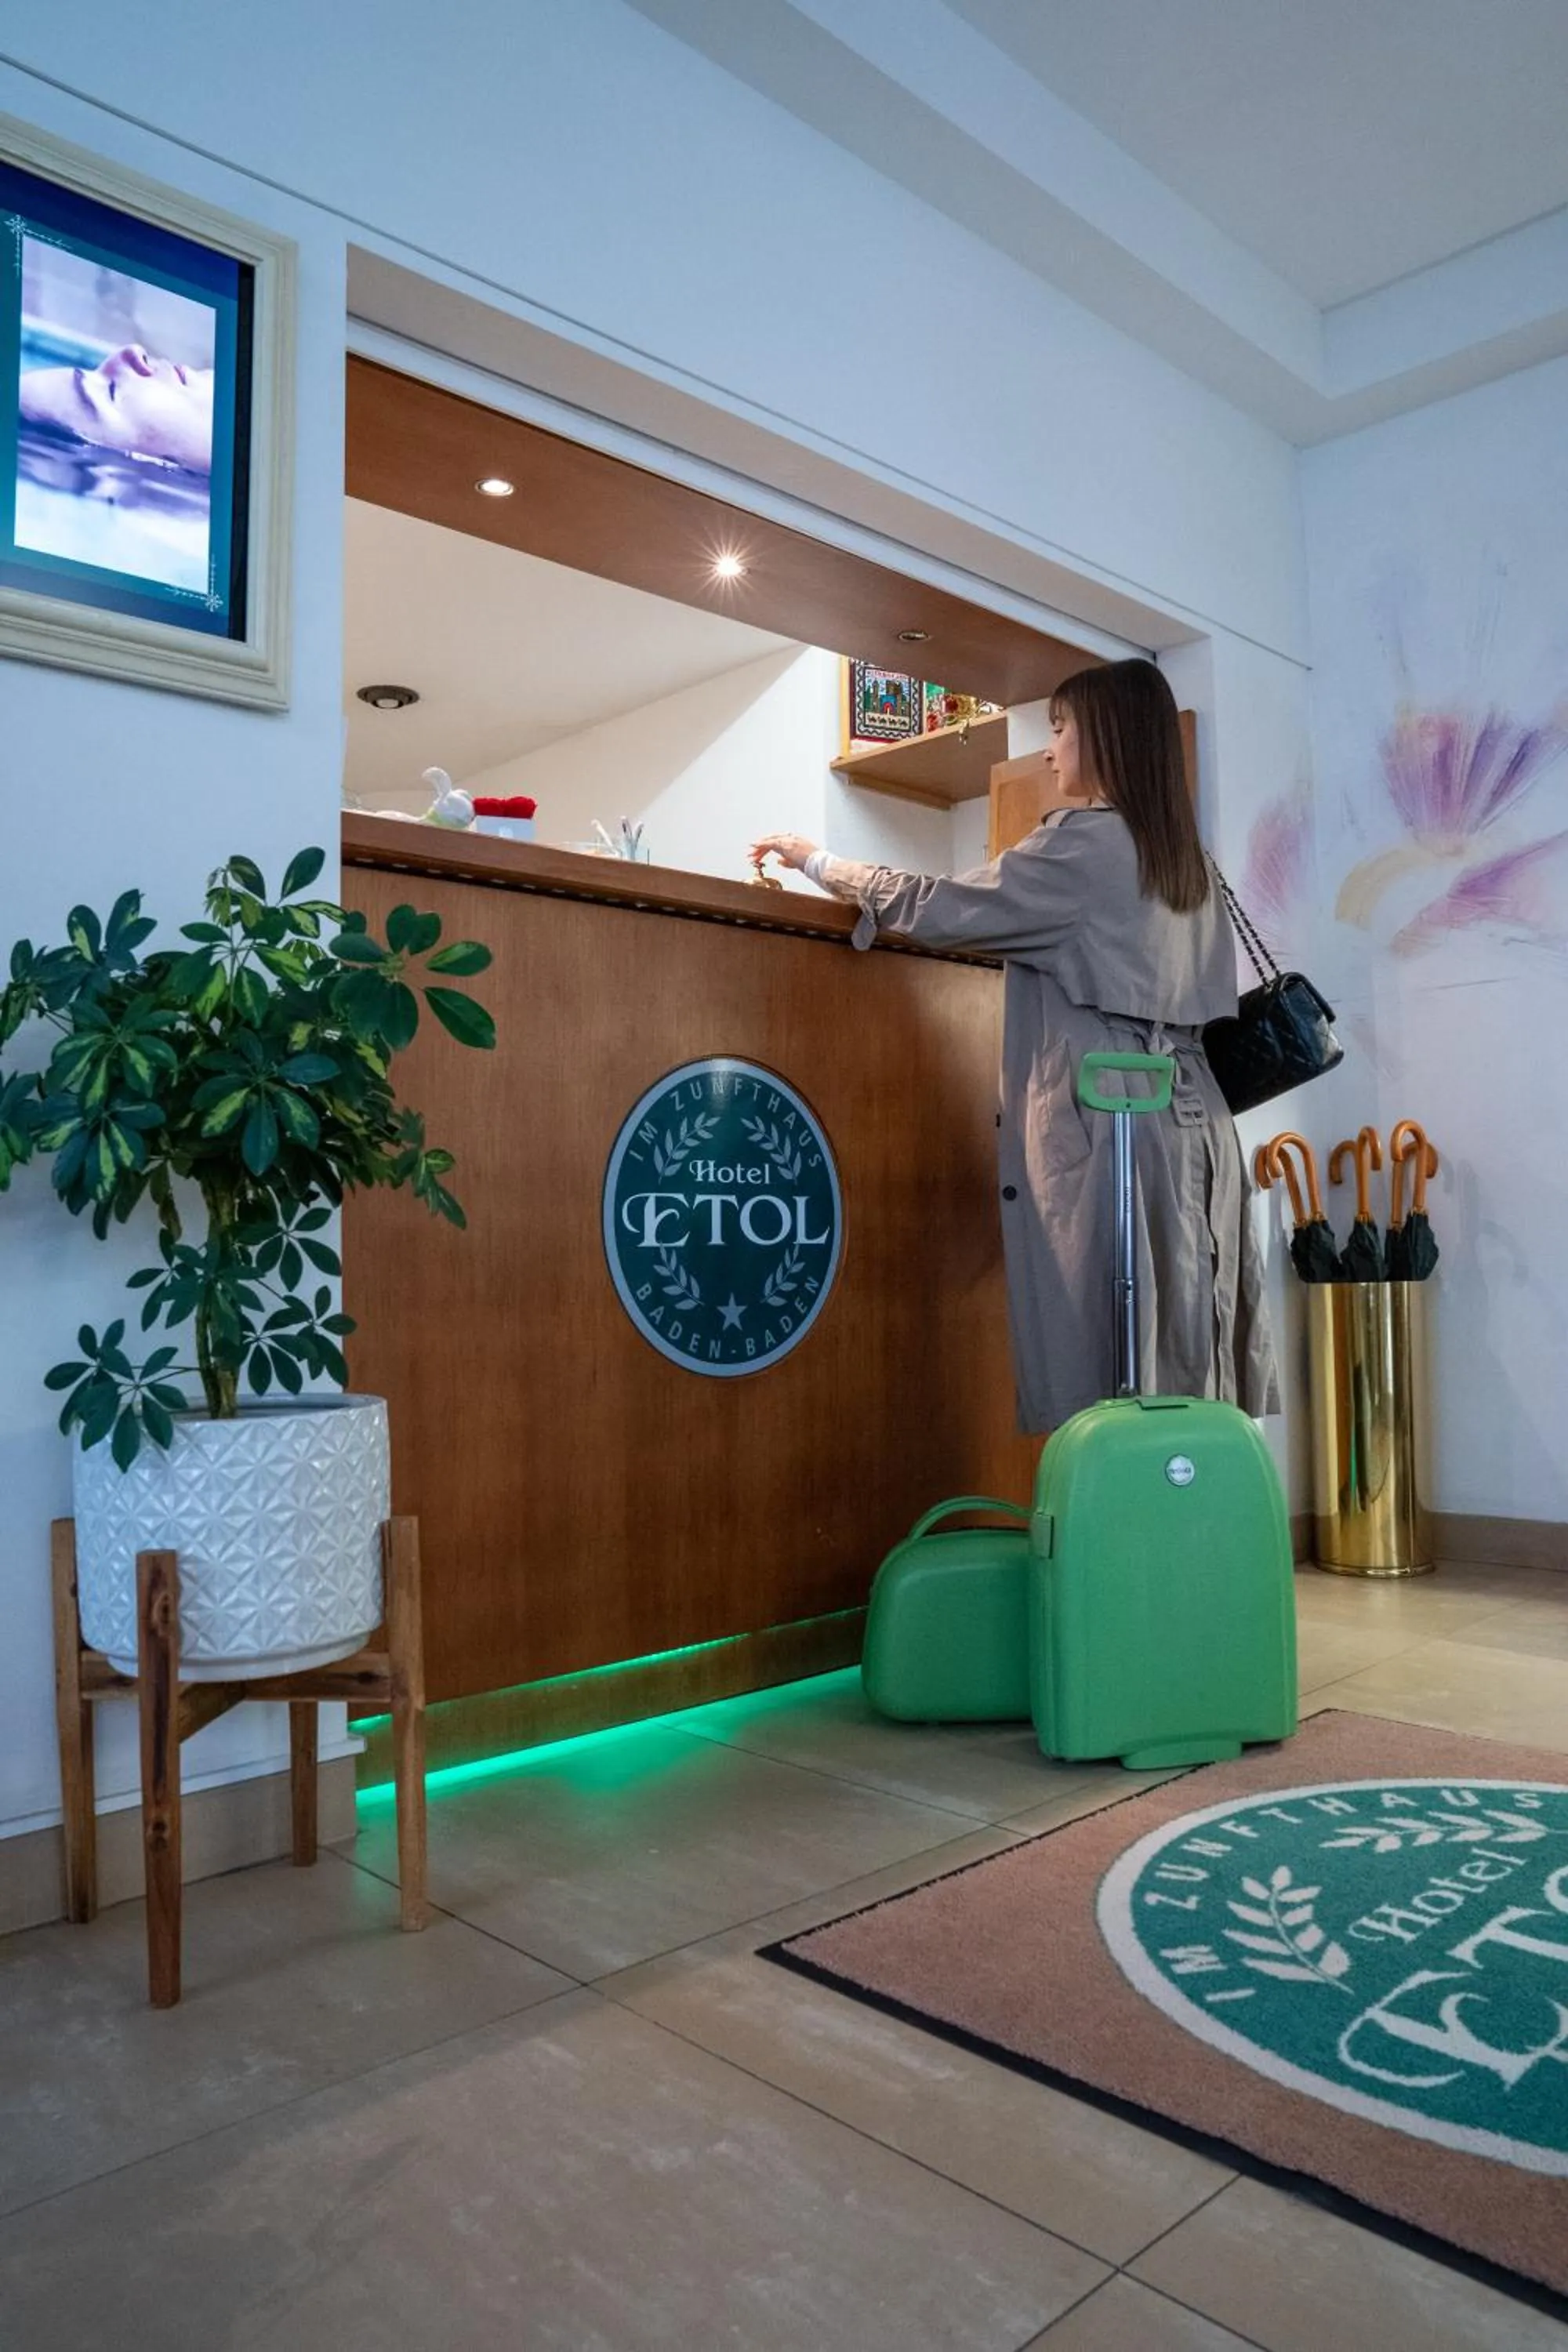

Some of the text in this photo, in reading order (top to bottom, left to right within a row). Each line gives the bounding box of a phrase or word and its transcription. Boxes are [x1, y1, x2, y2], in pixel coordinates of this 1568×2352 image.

[630, 1076, 823, 1167] IM ZUNFTHAUS
[689, 1160, 771, 1185] Hotel
[622, 1192, 831, 1247] ETOL
[637, 1276, 821, 1359] BADEN-BADEN
[1144, 1788, 1544, 2002] IM ZUNFTHAUS
[1348, 1847, 1527, 1944] Hotel
[1338, 1864, 1568, 2092] ET
